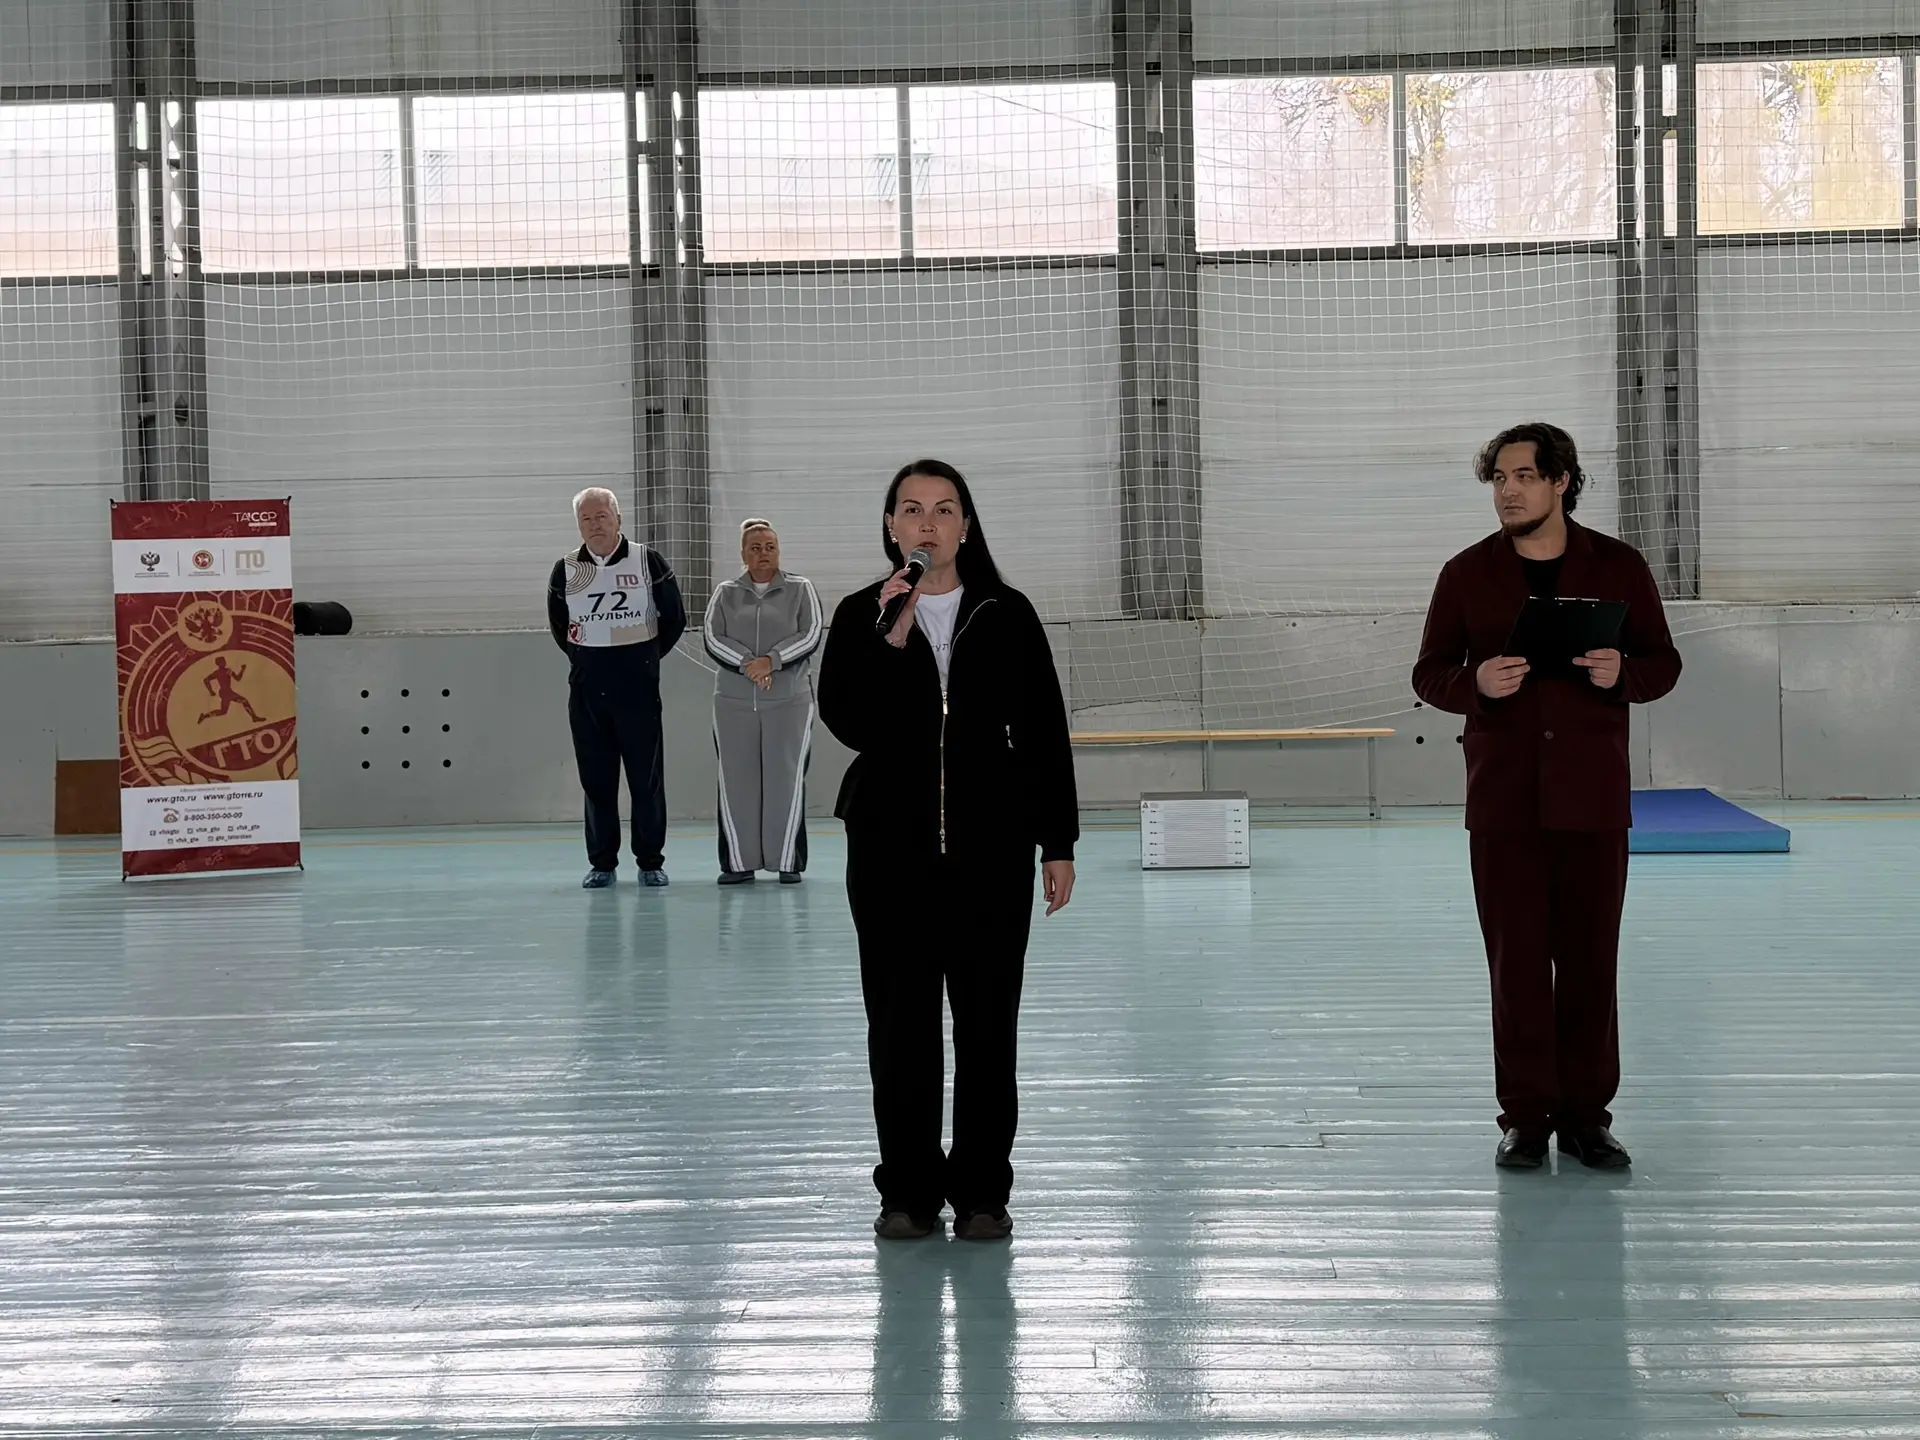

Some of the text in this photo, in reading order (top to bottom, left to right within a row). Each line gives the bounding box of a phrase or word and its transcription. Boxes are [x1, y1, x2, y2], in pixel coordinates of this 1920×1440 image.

[616, 574, 639, 586] ГТО
[587, 591, 629, 613] 72
[213, 728, 282, 768] ГТО
[147, 795, 197, 804] www.gto.ru
